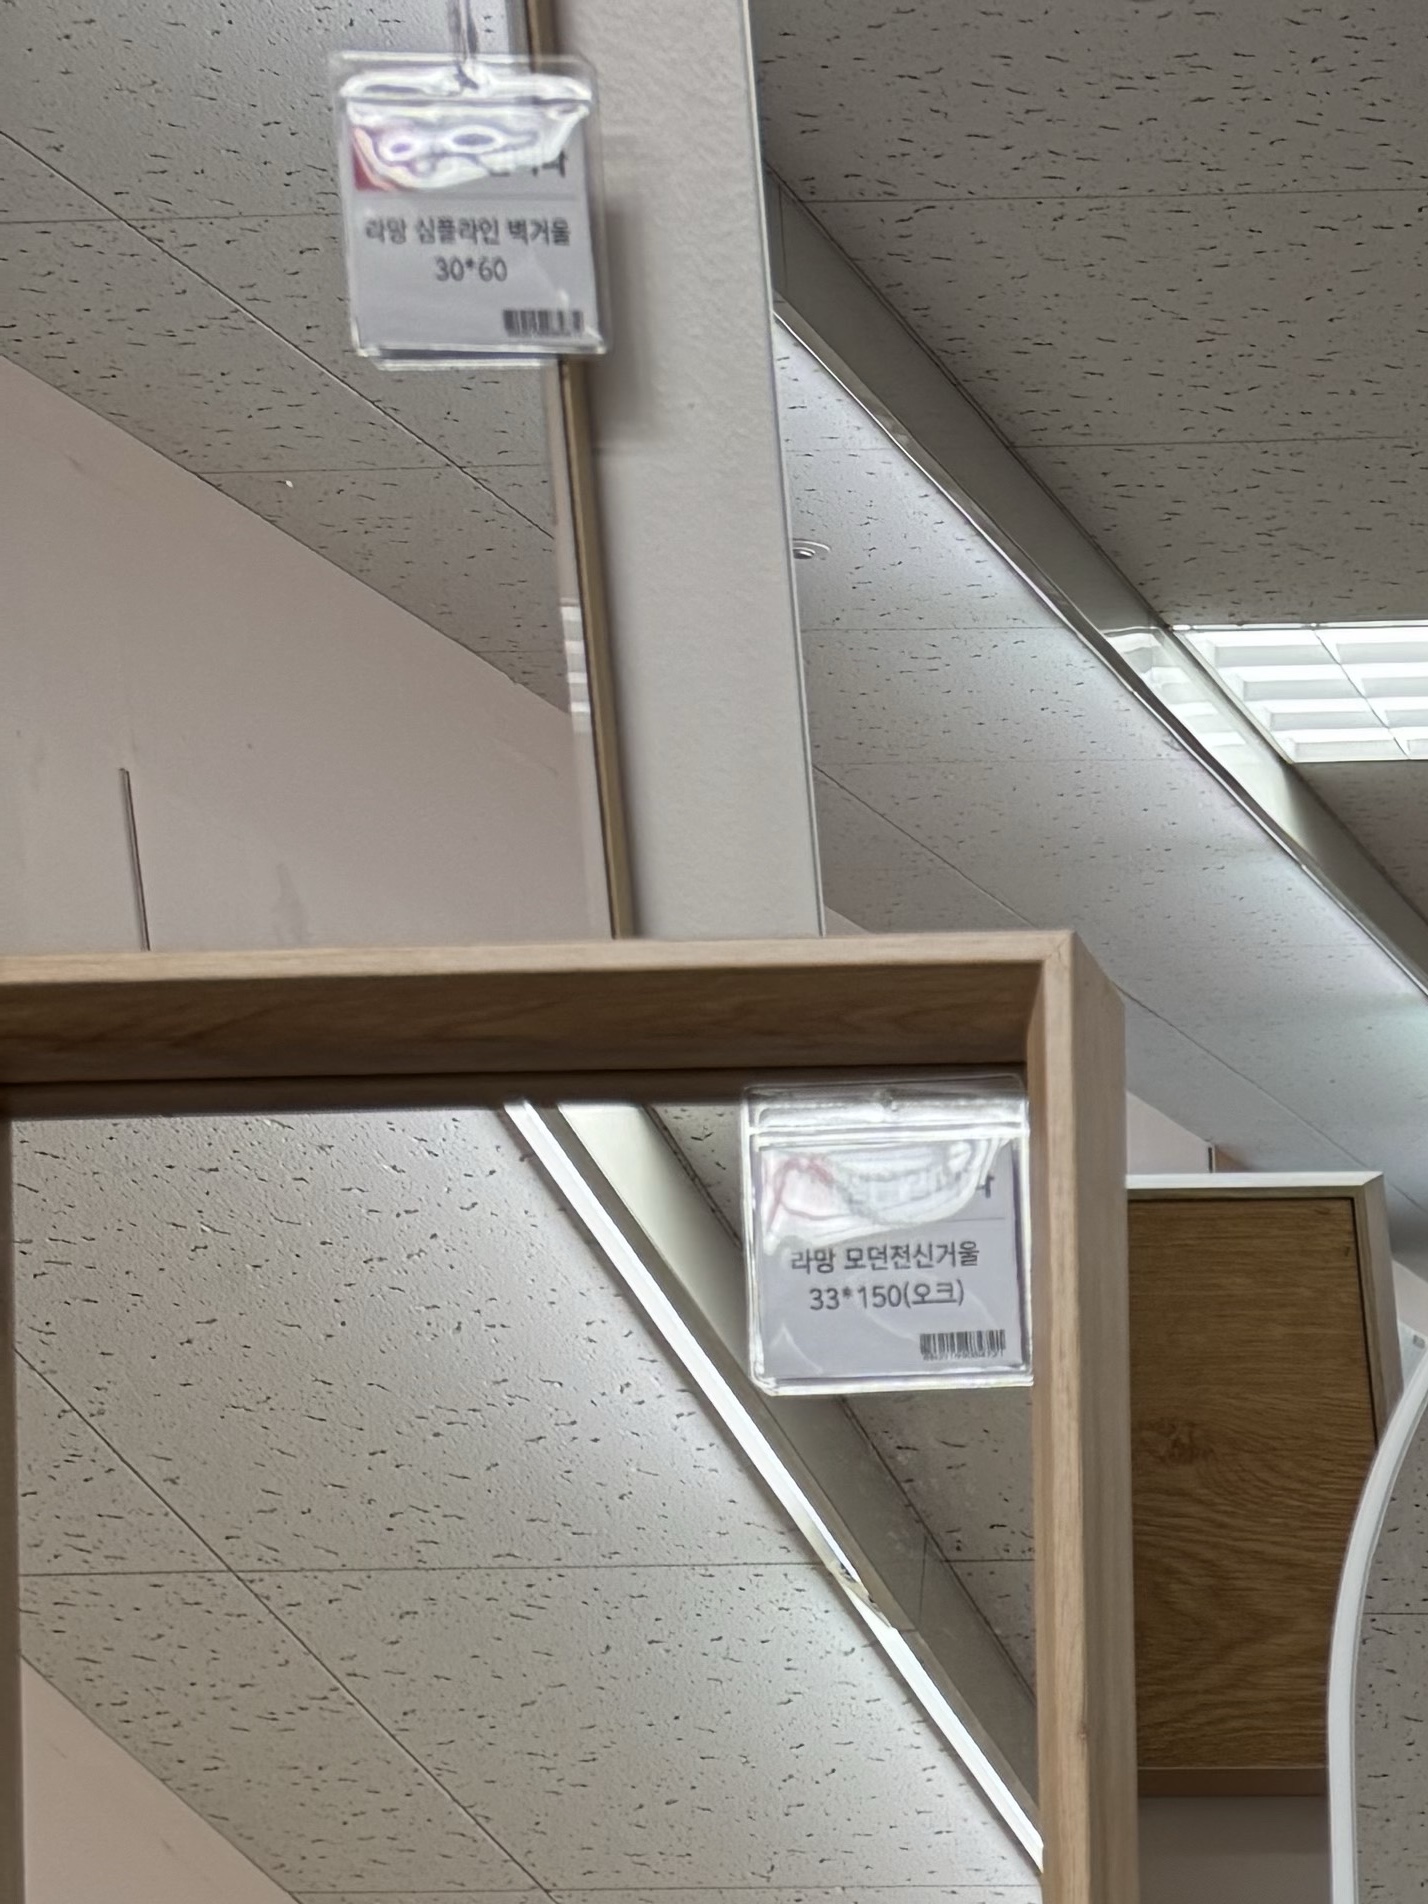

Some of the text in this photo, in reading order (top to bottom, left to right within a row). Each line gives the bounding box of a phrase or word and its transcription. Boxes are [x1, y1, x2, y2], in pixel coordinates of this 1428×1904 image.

[507, 217, 571, 247] 벽거울
[790, 1240, 979, 1276] 라망 모던전신거울
